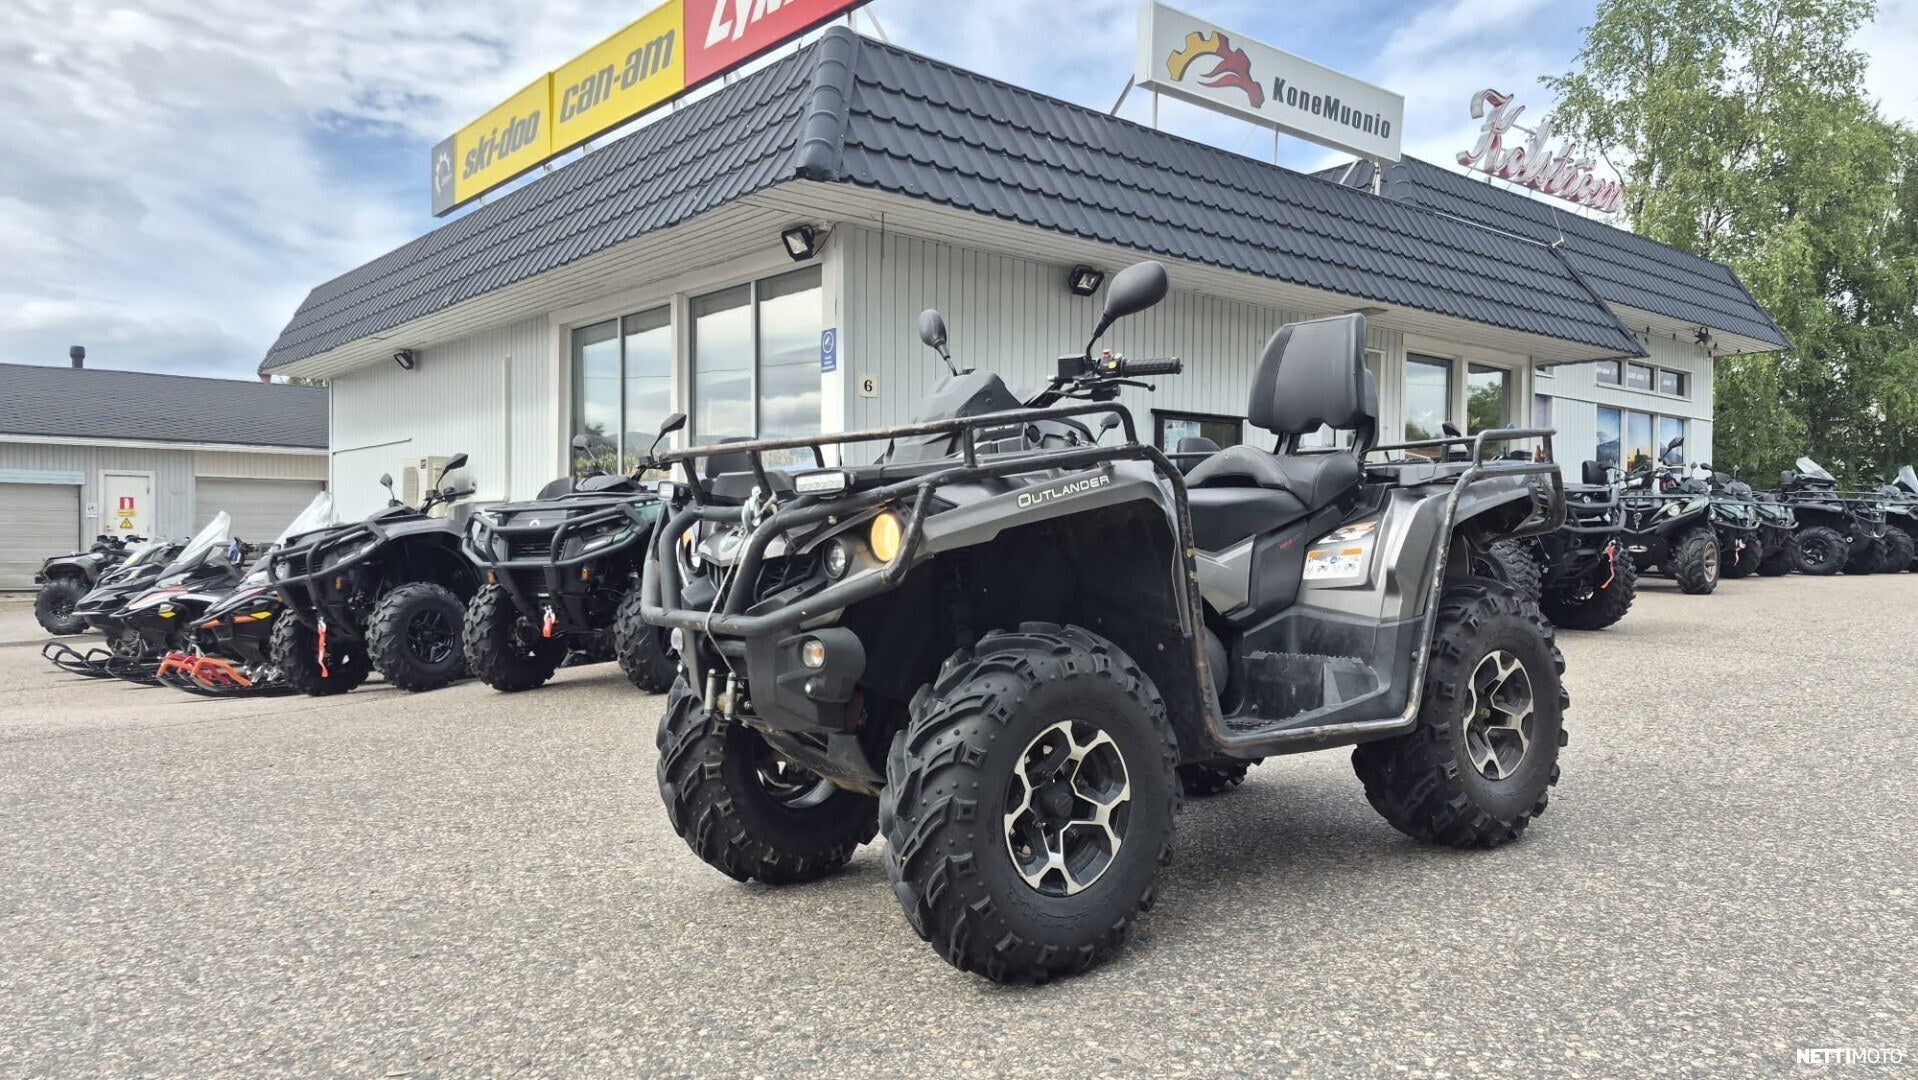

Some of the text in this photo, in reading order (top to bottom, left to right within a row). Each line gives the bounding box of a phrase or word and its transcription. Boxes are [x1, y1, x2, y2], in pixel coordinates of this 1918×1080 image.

[560, 28, 676, 124] can-am
[1272, 76, 1392, 139] KoneMuonio
[462, 110, 541, 180] ski-doo
[863, 379, 873, 393] 6
[1017, 475, 1110, 508] OUTLANDER
